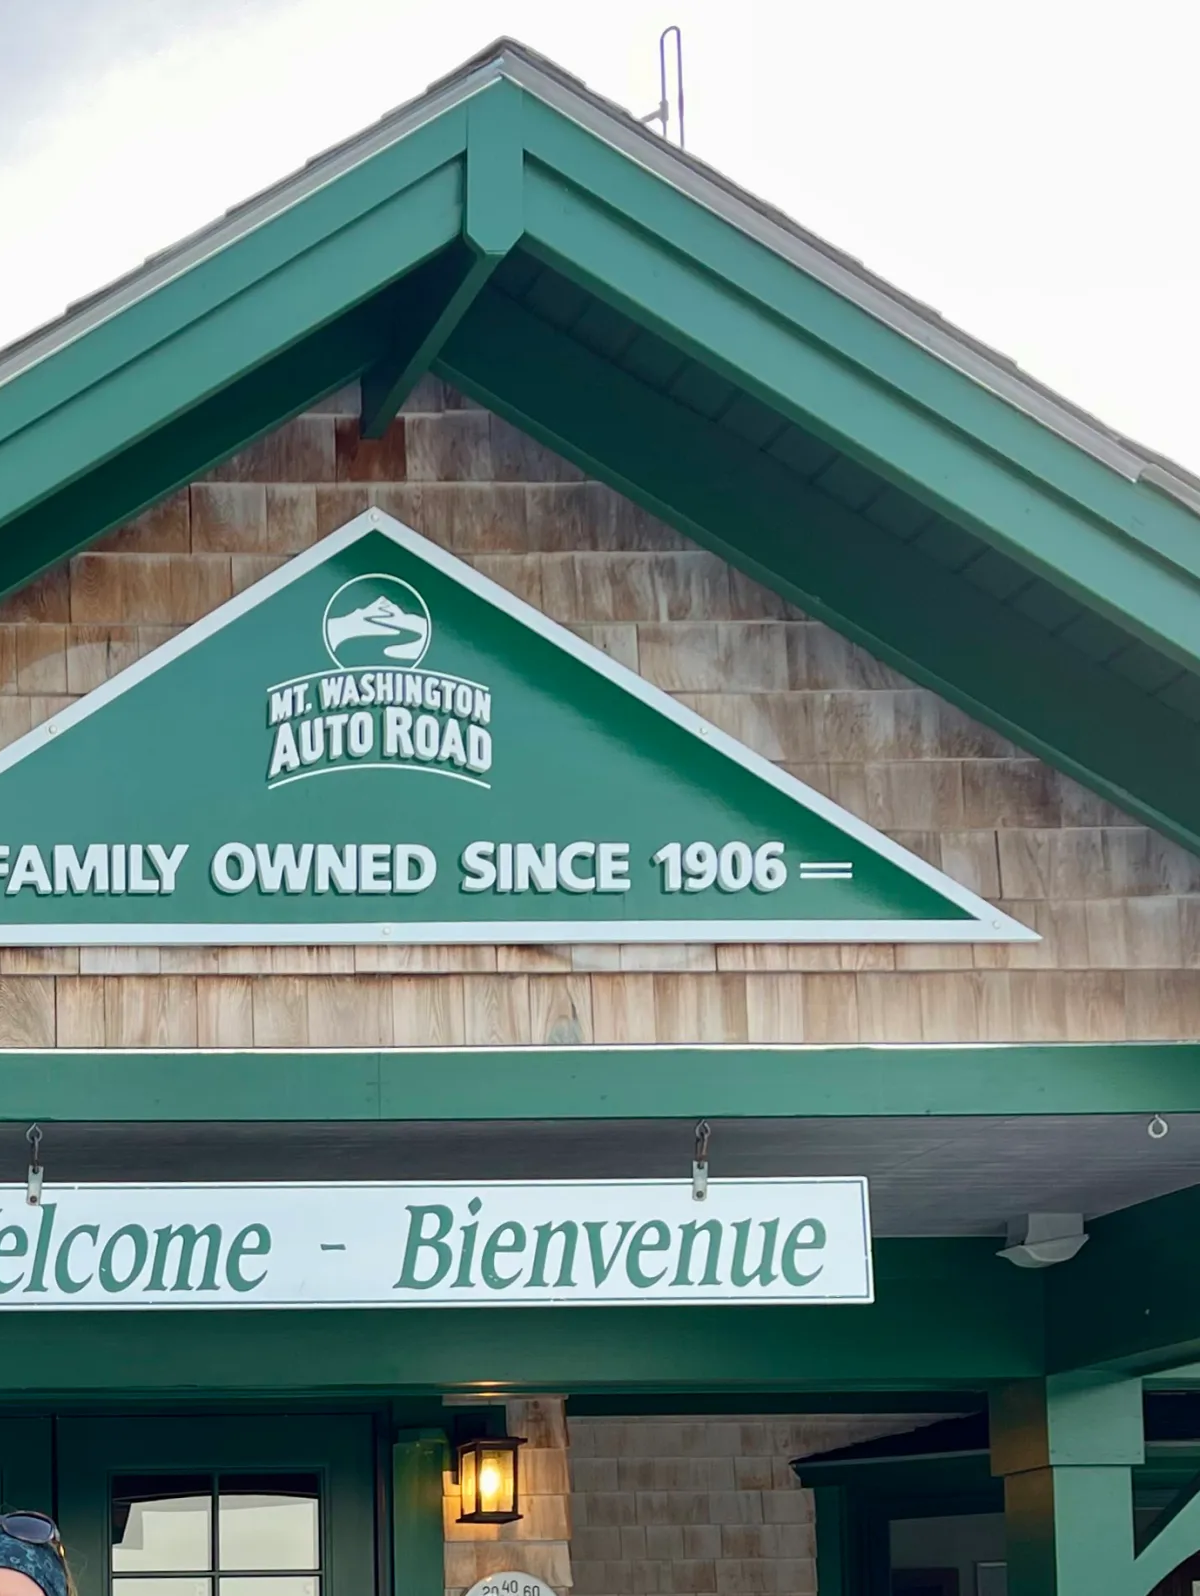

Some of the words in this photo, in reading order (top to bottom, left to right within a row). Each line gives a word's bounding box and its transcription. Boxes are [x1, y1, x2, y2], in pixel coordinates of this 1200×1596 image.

[269, 682, 312, 725] MT.
[320, 672, 491, 725] WASHINGTON
[268, 711, 374, 778] AUTO
[382, 705, 492, 773] ROAD
[211, 842, 438, 893] OWNED
[462, 841, 632, 892] SINCE
[654, 840, 788, 891] 1906
[394, 1196, 828, 1290] Bienvenue
[502, 1580, 518, 1593] 40
